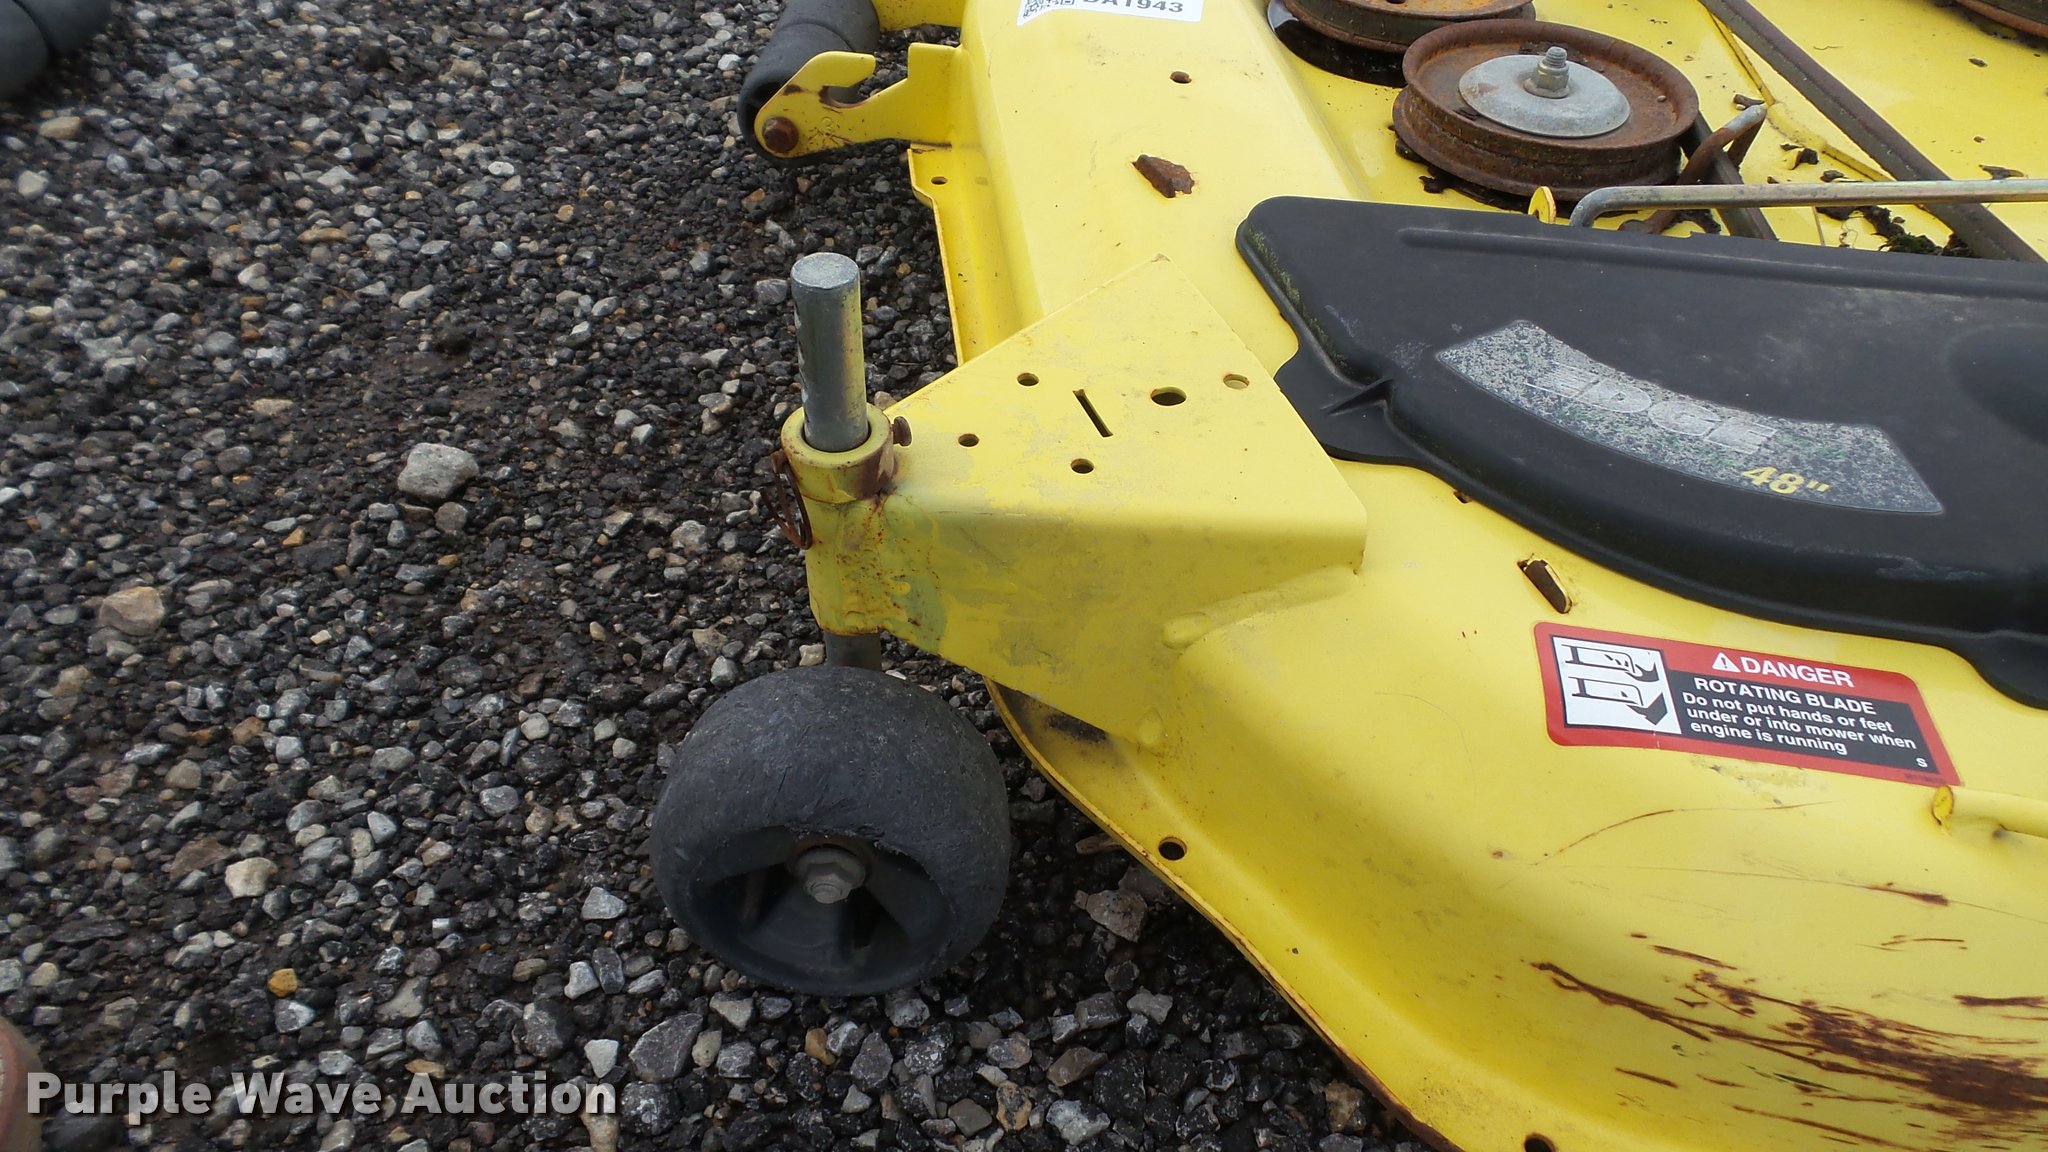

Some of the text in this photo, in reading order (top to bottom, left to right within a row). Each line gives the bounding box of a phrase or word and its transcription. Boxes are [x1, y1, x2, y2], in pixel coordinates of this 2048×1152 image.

[1083, 0, 1183, 12] A1943
[1743, 466, 1830, 494] 48"
[1740, 656, 1854, 688] DANGER
[1682, 692, 1895, 733] Do not put hands or feet
[1693, 677, 1877, 715] ROTATING BLADE
[1687, 708, 1917, 749] under or into mower when
[1691, 722, 1848, 755] engine is running
